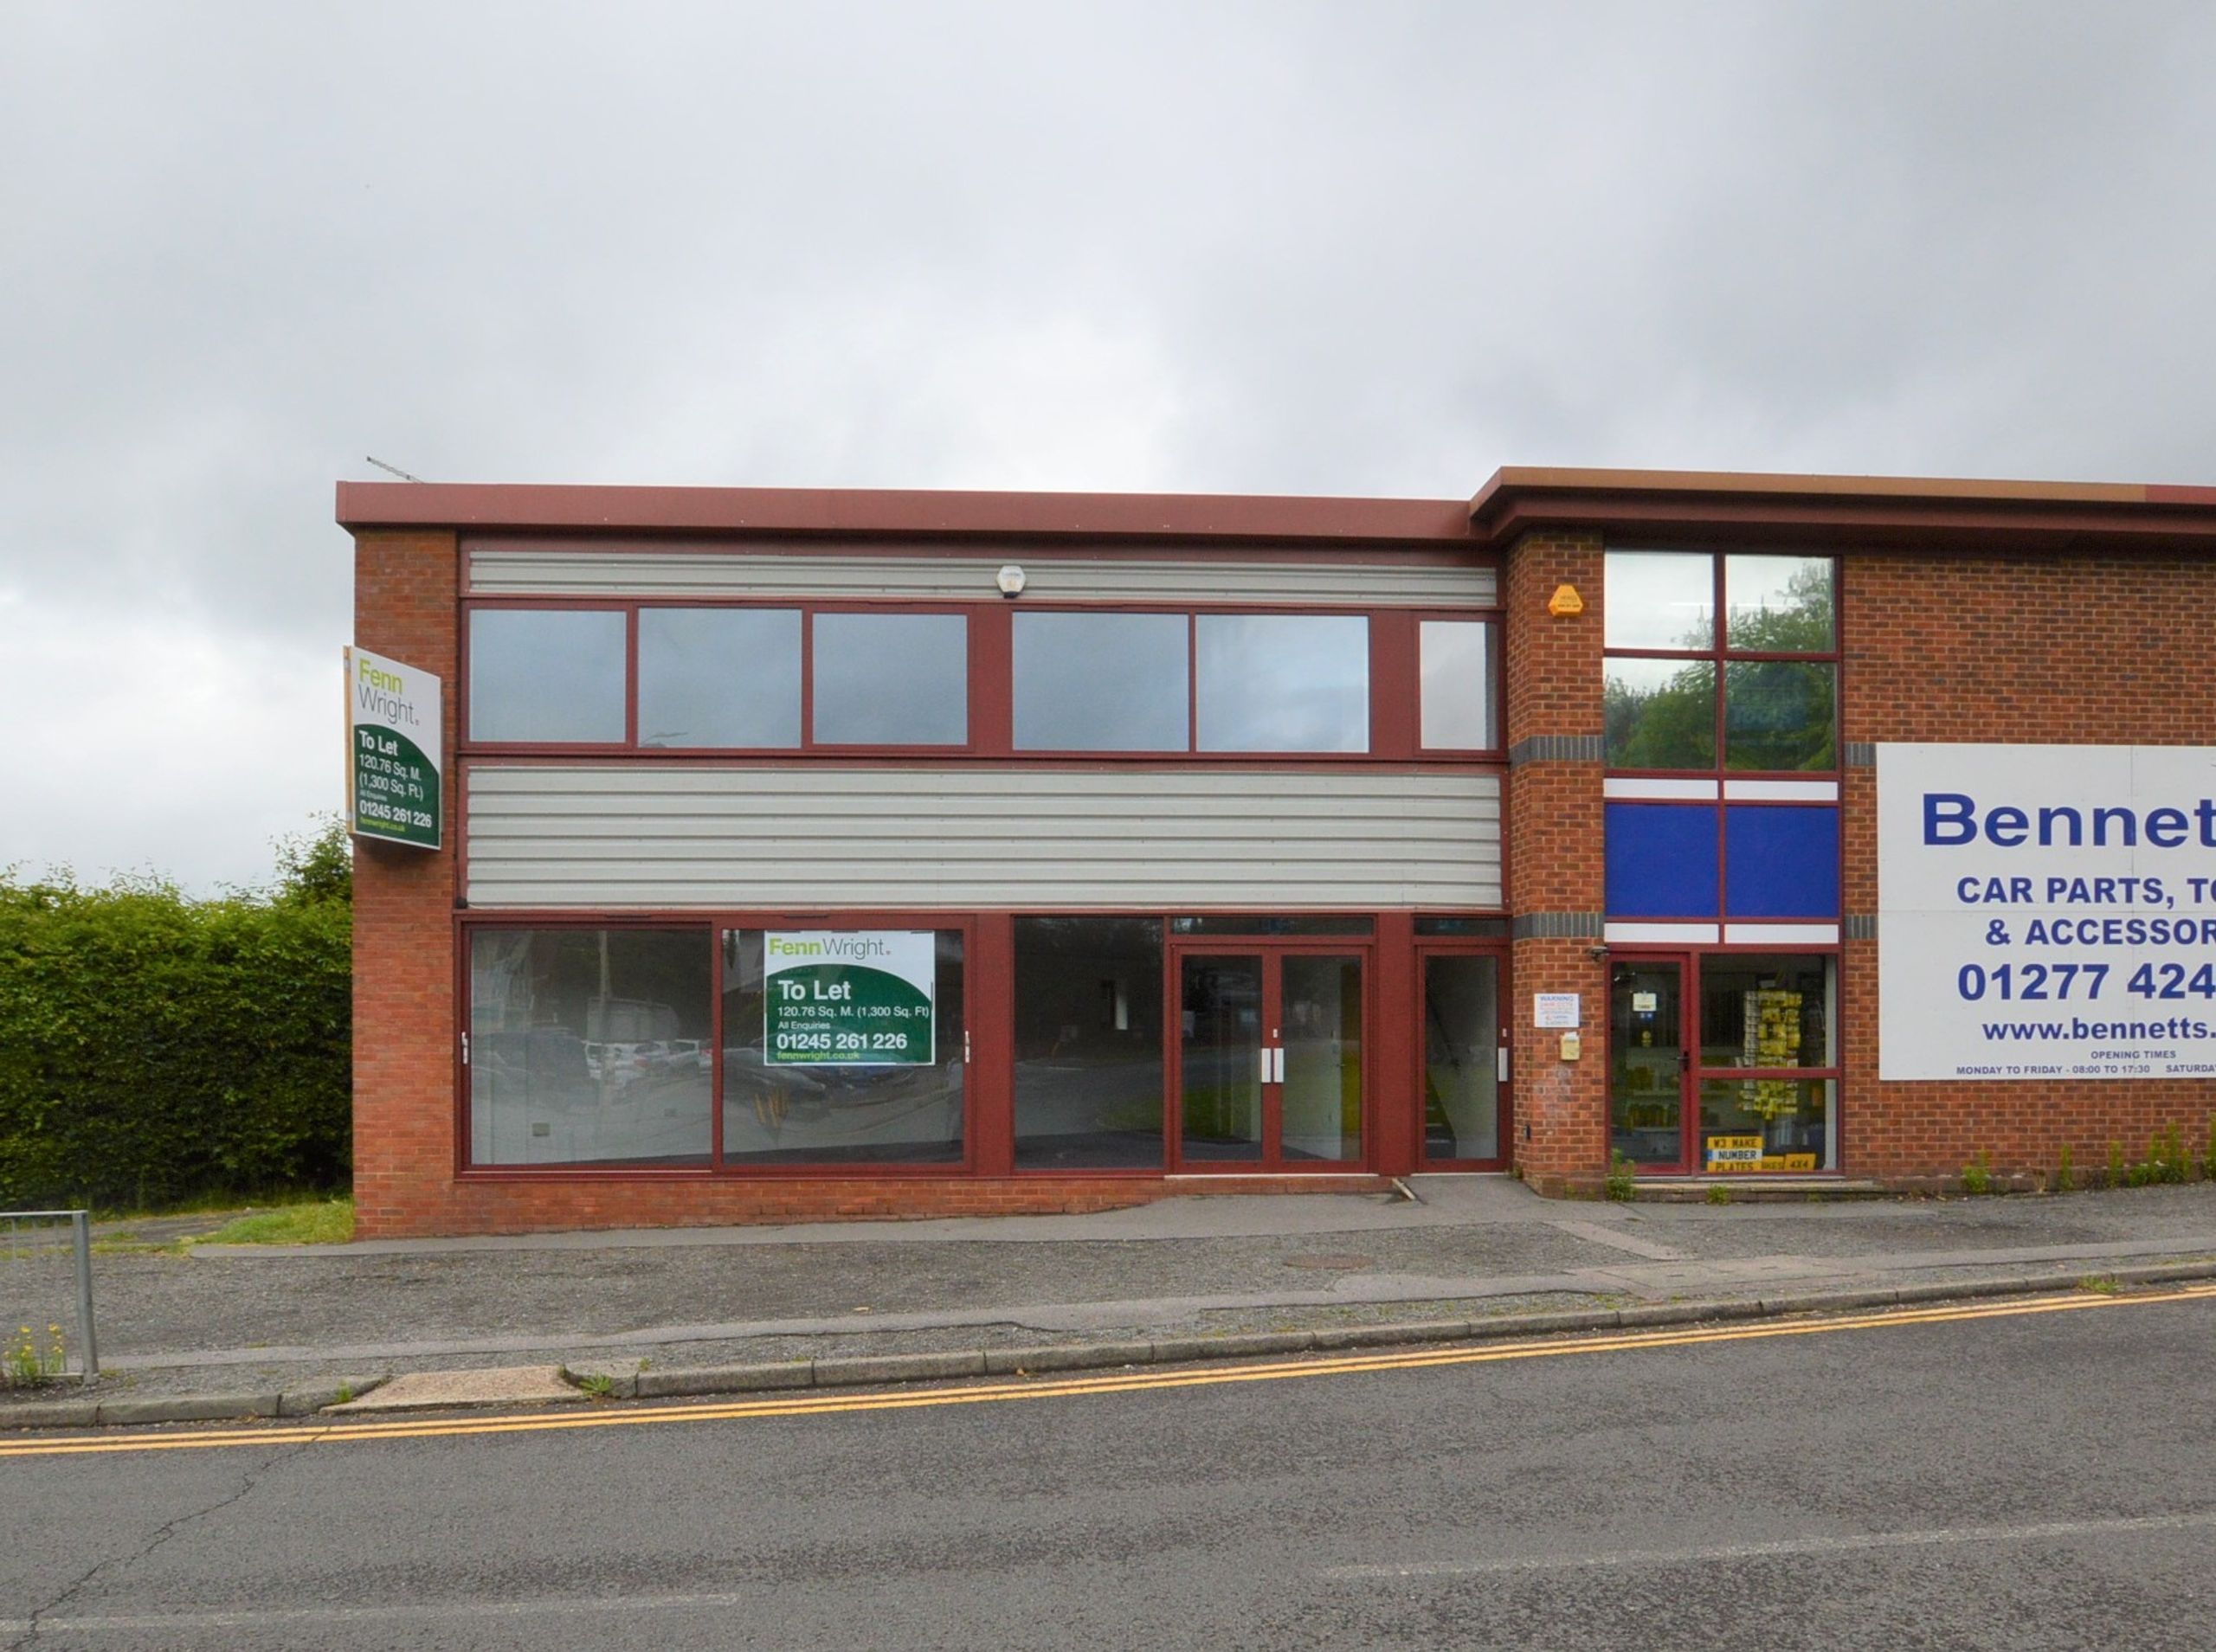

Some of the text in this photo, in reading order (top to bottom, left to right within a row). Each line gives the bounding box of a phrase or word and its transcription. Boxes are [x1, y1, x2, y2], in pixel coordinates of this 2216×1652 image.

[359, 659, 403, 695] Fenn
[358, 730, 398, 756] To Let
[359, 754, 392, 774] 120.76
[392, 762, 409, 781] Sq.
[359, 771, 390, 791] (1,300
[390, 779, 407, 798] Sq.
[359, 800, 432, 828] 01245 261 226
[1923, 793, 2216, 848] Bennet
[1956, 877, 2216, 910] CAR PARTS, T
[1985, 919, 2216, 946] & ACCESSOR
[777, 980, 852, 1000] To Let
[1957, 963, 2216, 1001] 01277 424
[777, 1006, 815, 1017] 120.76
[817, 1006, 837, 1019] Sq.
[840, 1006, 854, 1017] M.
[857, 1006, 892, 1019] (1,300
[893, 1006, 912, 1019] Sq.
[777, 1020, 831, 1031] All Enquiries
[1981, 1016, 2216, 1039] www.bennetts.
[776, 1033, 908, 1050] 01245 261 226
[776, 1051, 860, 1061] fennwright.co.uk
[2090, 1050, 2177, 1060] OPENING TIMES
[1955, 1066, 2003, 1075] MONDAY
[2006, 1065, 2021, 1074] TO
[2023, 1065, 2063, 1074] FRIDAY
[2071, 1064, 2101, 1074] 08:00
[2122, 1064, 2151, 1073] 17:30
[2165, 1064, 2216, 1073] SATURDA
[1731, 1138, 1756, 1148] MAKE
[1718, 1150, 1757, 1160] NUMBER
[1716, 1162, 1754, 1172] PLATES
